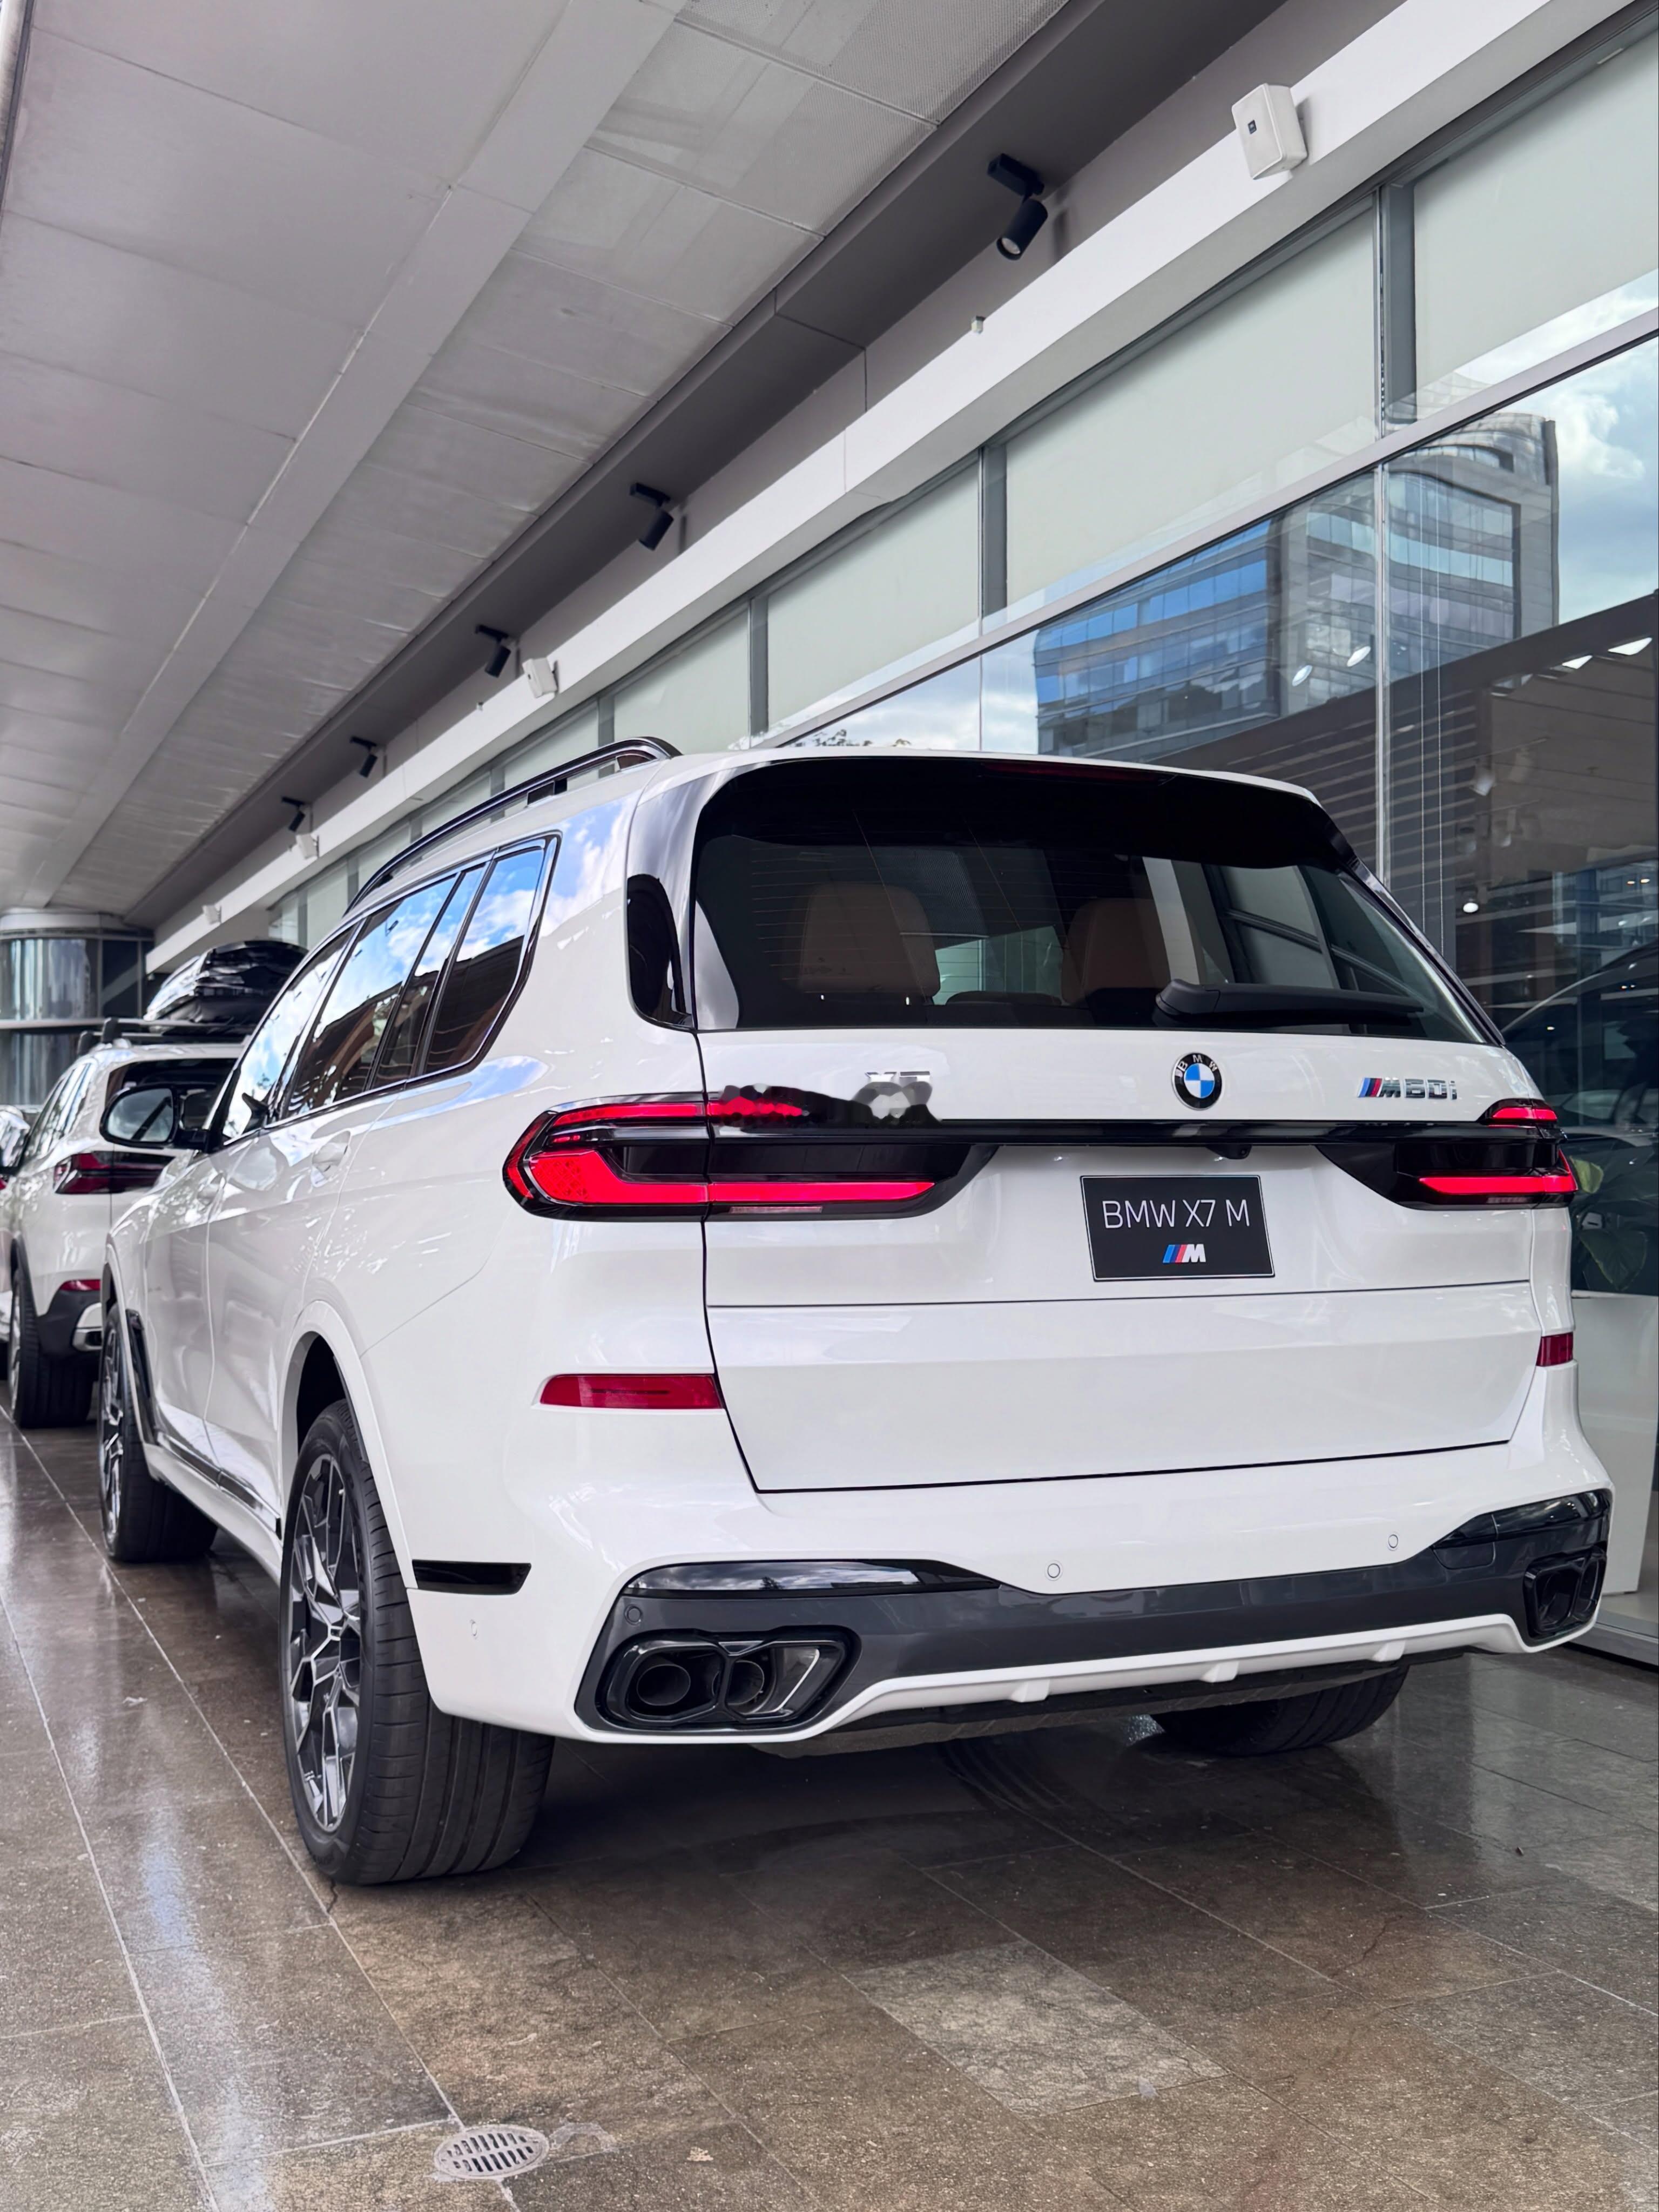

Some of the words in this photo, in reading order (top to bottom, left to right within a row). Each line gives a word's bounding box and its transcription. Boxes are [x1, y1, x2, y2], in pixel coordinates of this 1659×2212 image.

[1177, 1054, 1217, 1072] BMW
[1102, 1200, 1176, 1228] BMW
[1183, 1199, 1215, 1227] X7
[1225, 1199, 1250, 1226] M
[1182, 1244, 1206, 1263] M
